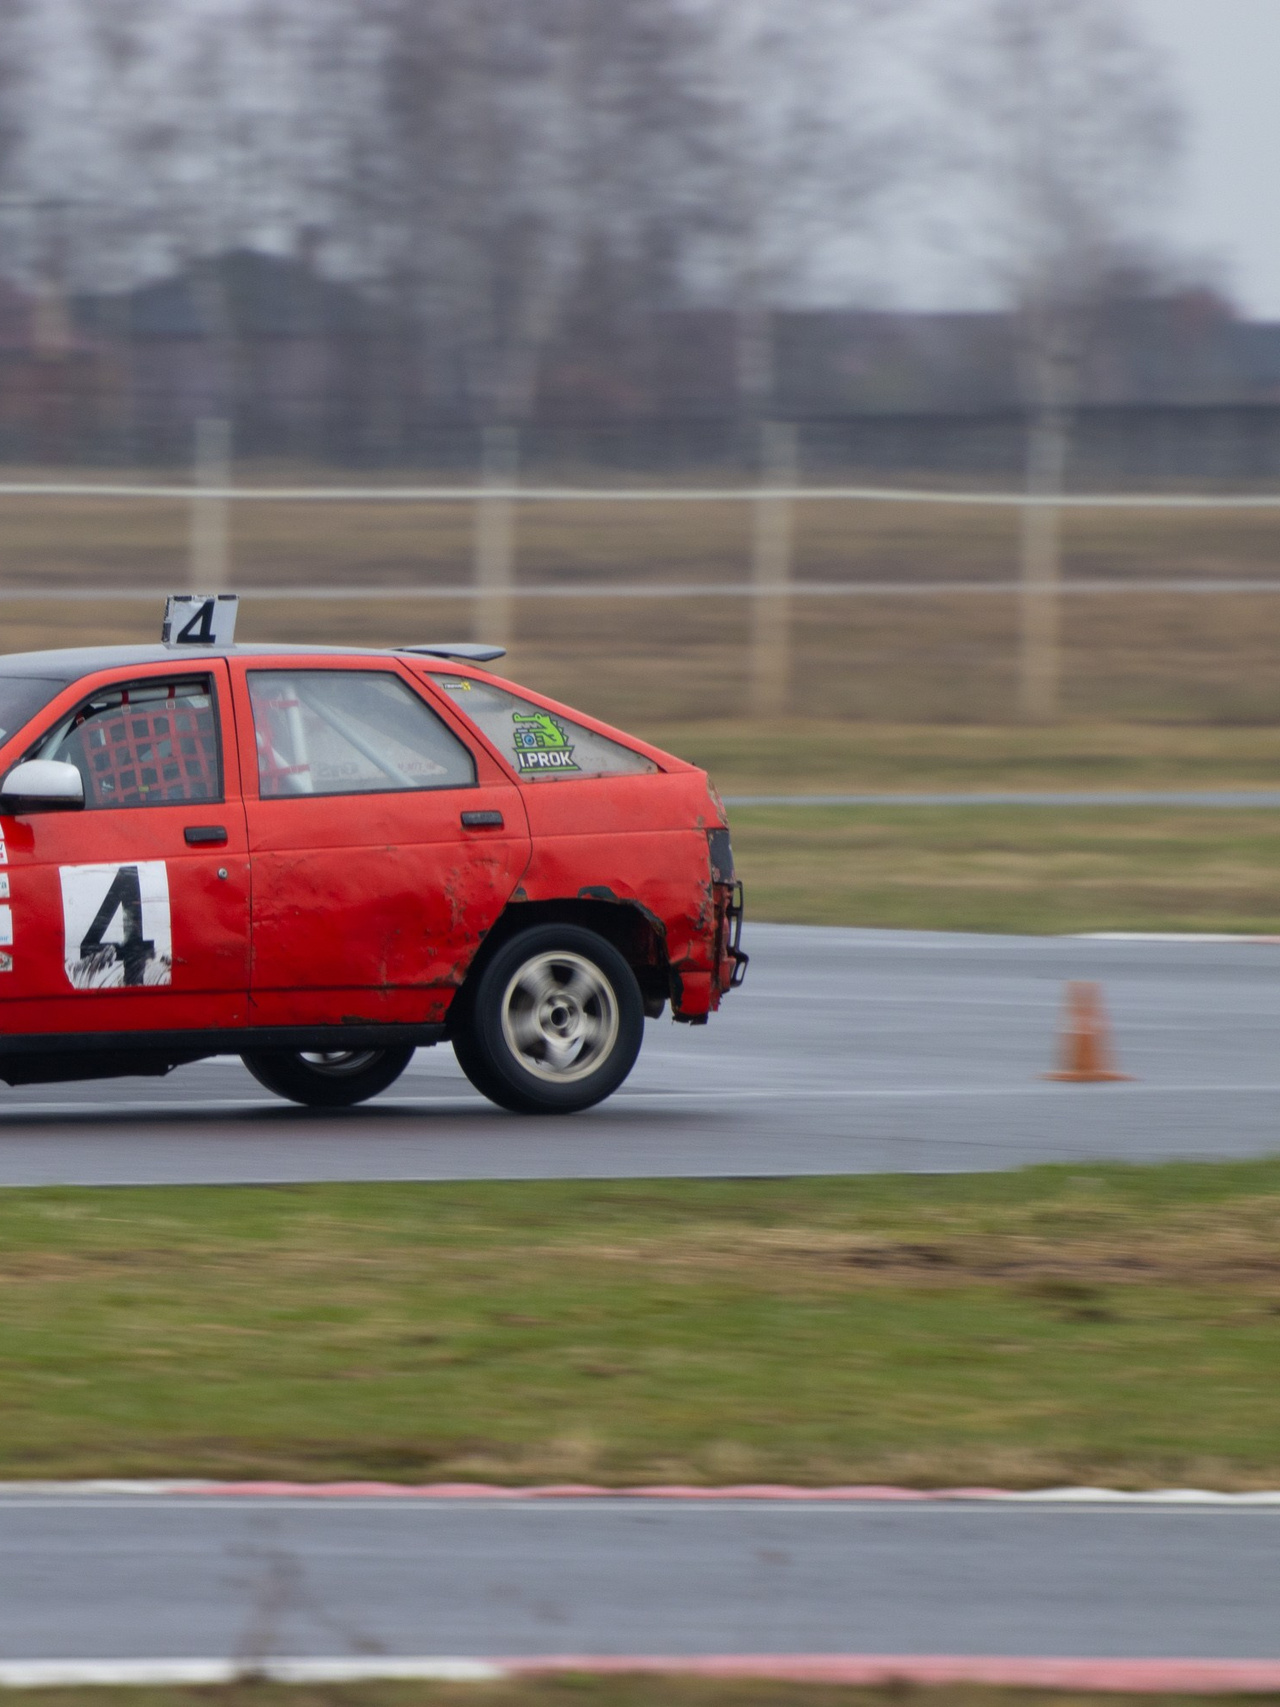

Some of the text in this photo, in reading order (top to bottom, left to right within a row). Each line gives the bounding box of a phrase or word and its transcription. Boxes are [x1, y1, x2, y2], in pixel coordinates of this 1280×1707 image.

[176, 598, 216, 644] 4
[519, 751, 573, 768] I.PROK
[80, 866, 155, 985] 4
